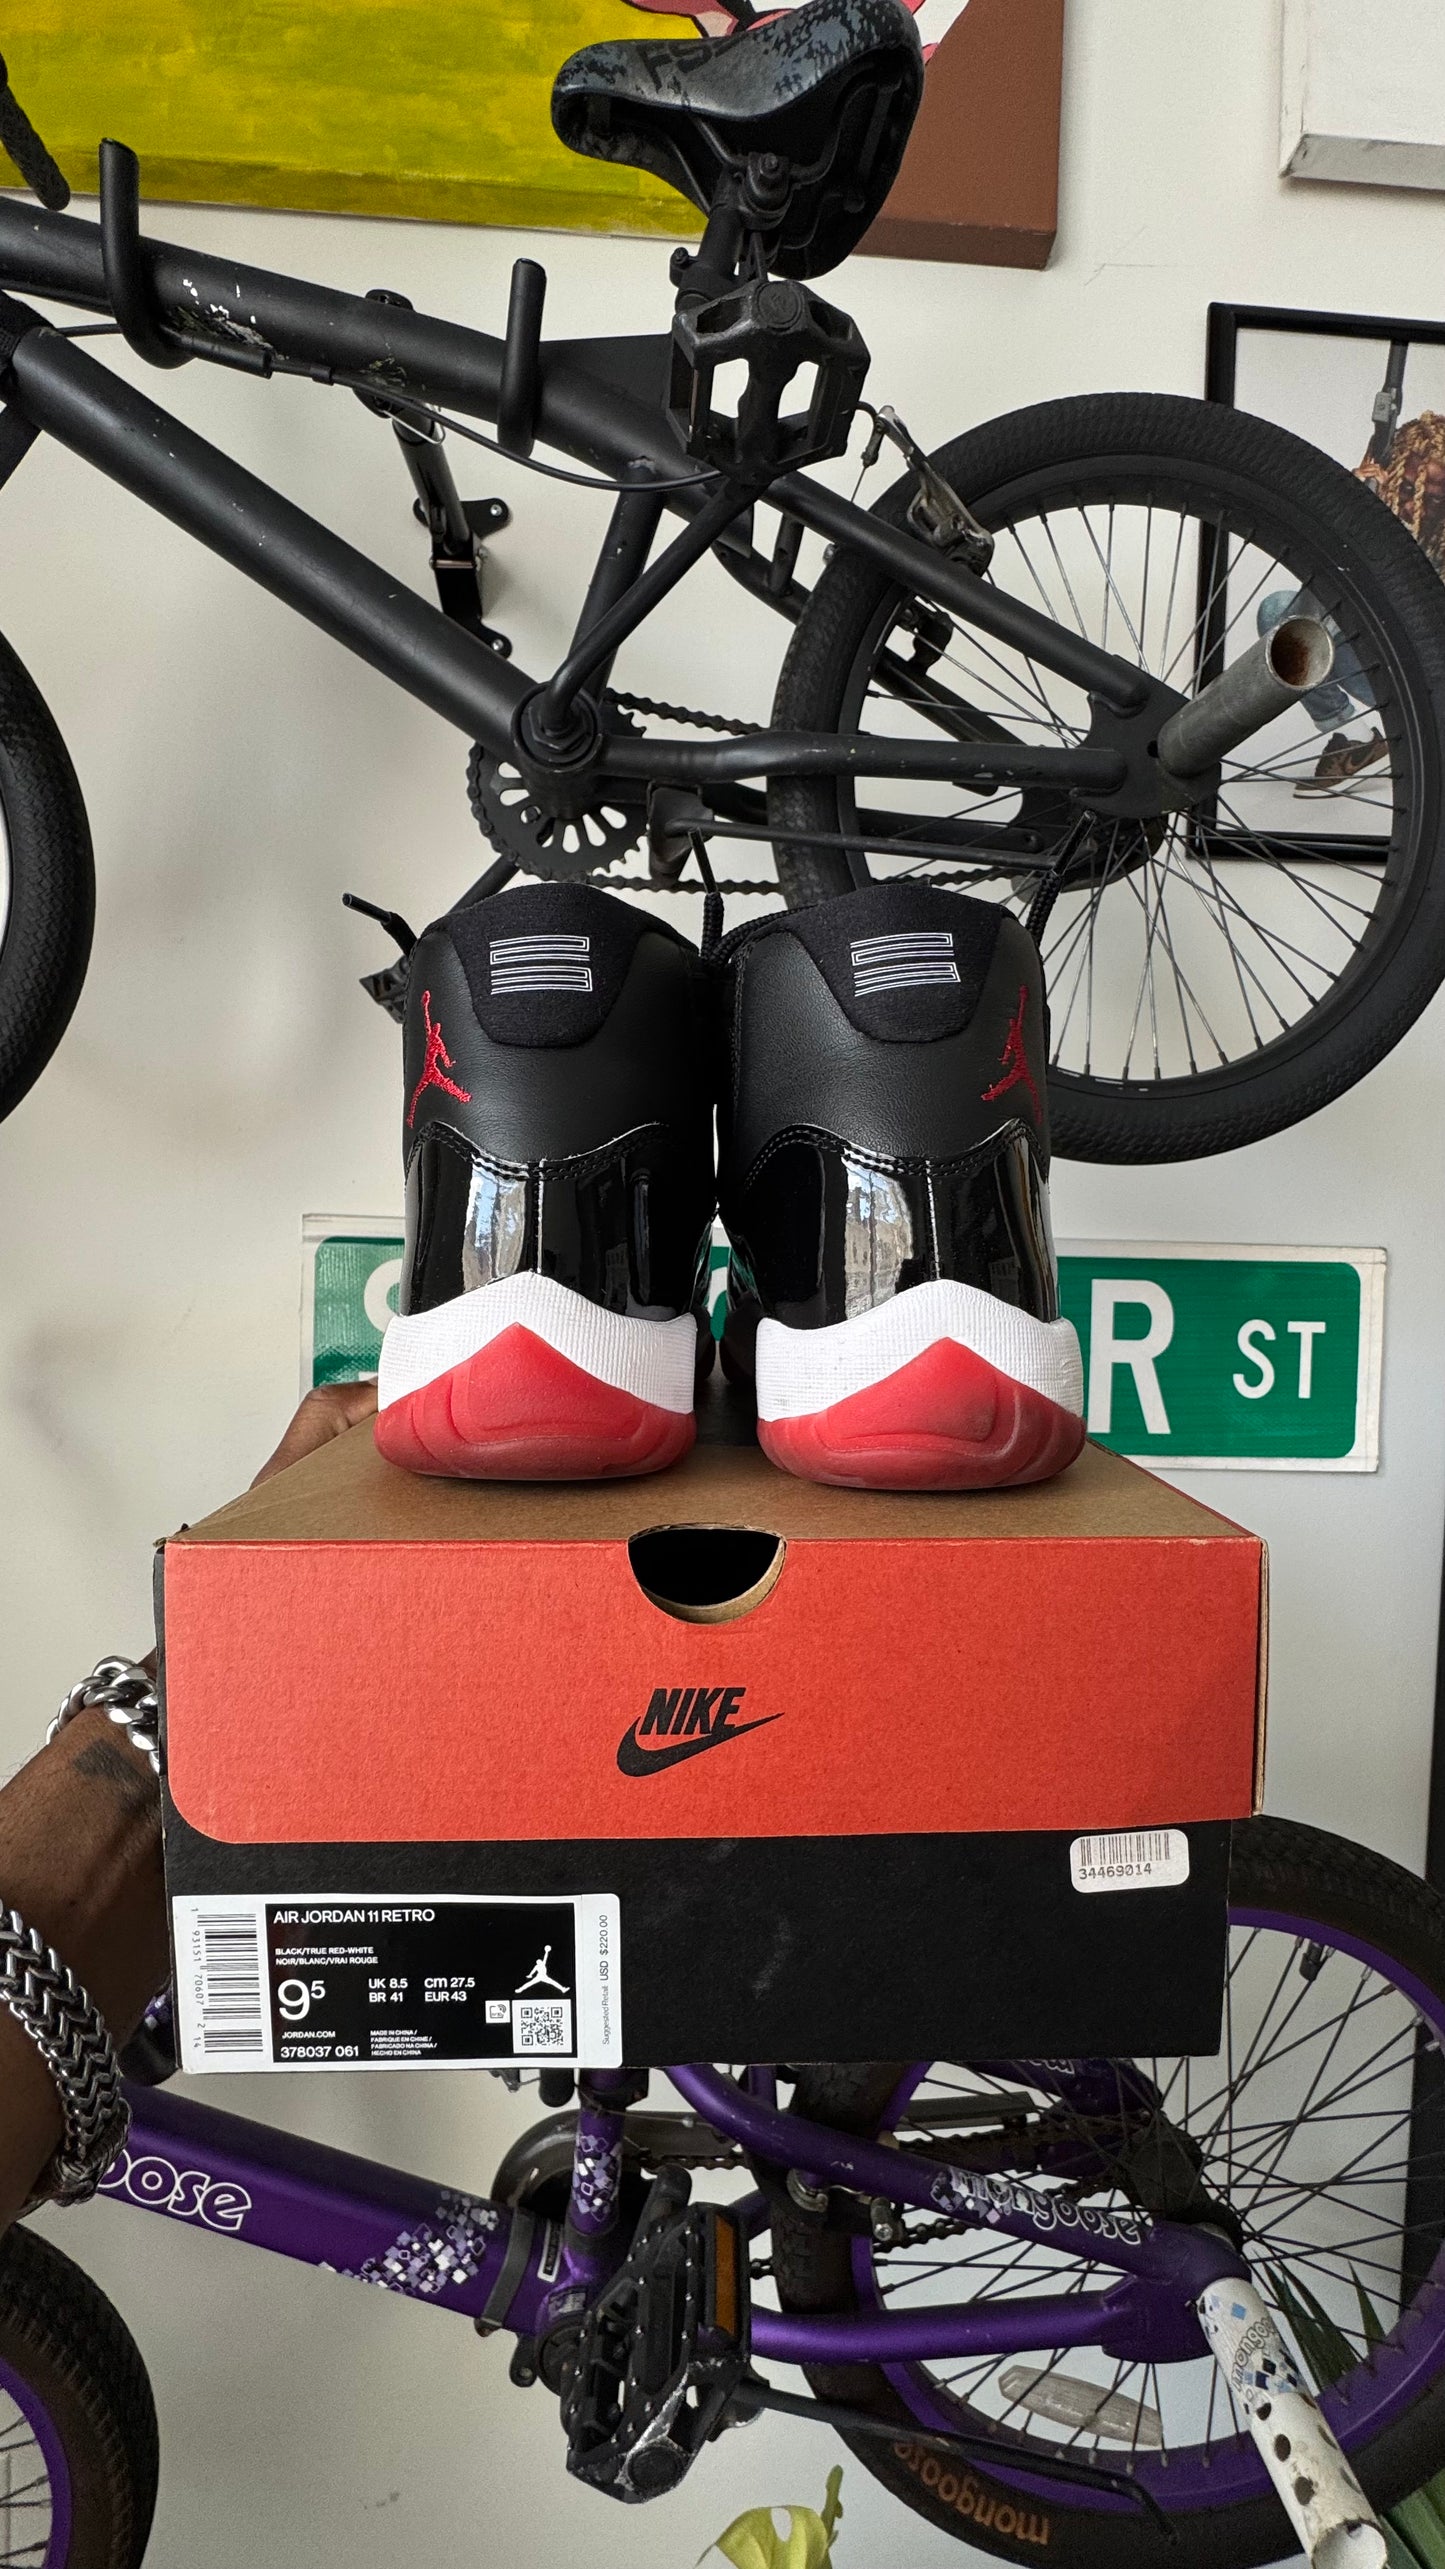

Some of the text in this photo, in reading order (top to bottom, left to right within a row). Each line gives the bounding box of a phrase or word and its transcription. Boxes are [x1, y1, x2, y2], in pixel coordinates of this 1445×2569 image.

[1232, 1319, 1326, 1399] ST
[638, 1687, 747, 1735] NIKE
[1078, 1862, 1152, 1880] 34469014
[273, 1908, 435, 1924] AIR JORDAN 11 RETRO
[598, 1914, 609, 1956] $220.00
[192, 1930, 202, 1962] 93151
[275, 1946, 374, 1956] BLACK/TRUE RED-WHITE
[275, 1956, 378, 1966] NOIR/BLANC/VRAI ROUGE
[599, 1960, 609, 1981] USD
[194, 1975, 204, 2006] 70607
[368, 1978, 386, 1989] UK
[389, 1978, 408, 1988] 8.5
[450, 1977, 476, 1988] 27.5
[369, 1991, 467, 2003] BR 41 EUR 43
[281, 2030, 336, 2039] JORDAN.COM
[280, 2046, 359, 2058] 378037 061
